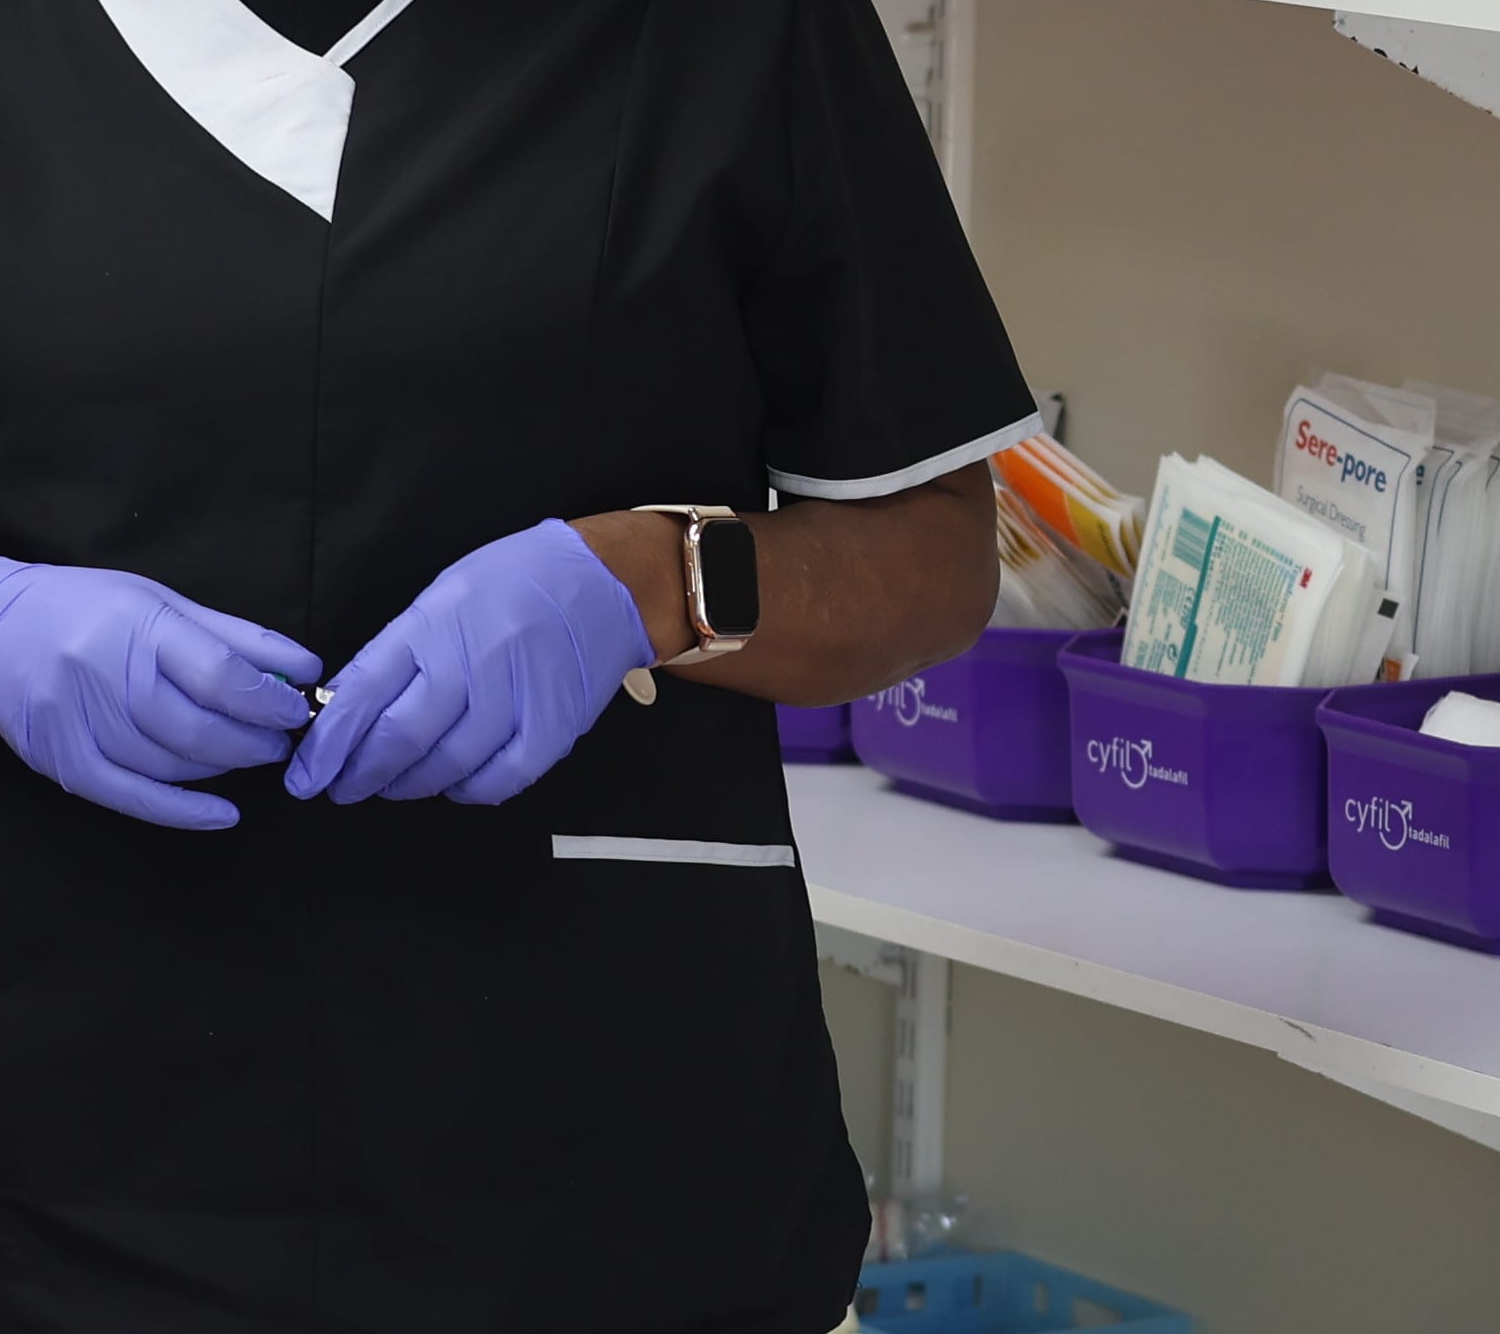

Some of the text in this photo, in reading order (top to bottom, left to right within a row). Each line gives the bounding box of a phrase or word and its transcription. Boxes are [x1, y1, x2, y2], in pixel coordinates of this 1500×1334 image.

[1296, 420, 1387, 492] Sere-pore
[1329, 502, 1366, 543] Dressing
[921, 703, 958, 723] tadalafil
[1088, 736, 1189, 786] cyfil tadalafil
[1345, 795, 1451, 850] cyfil tadalafil
